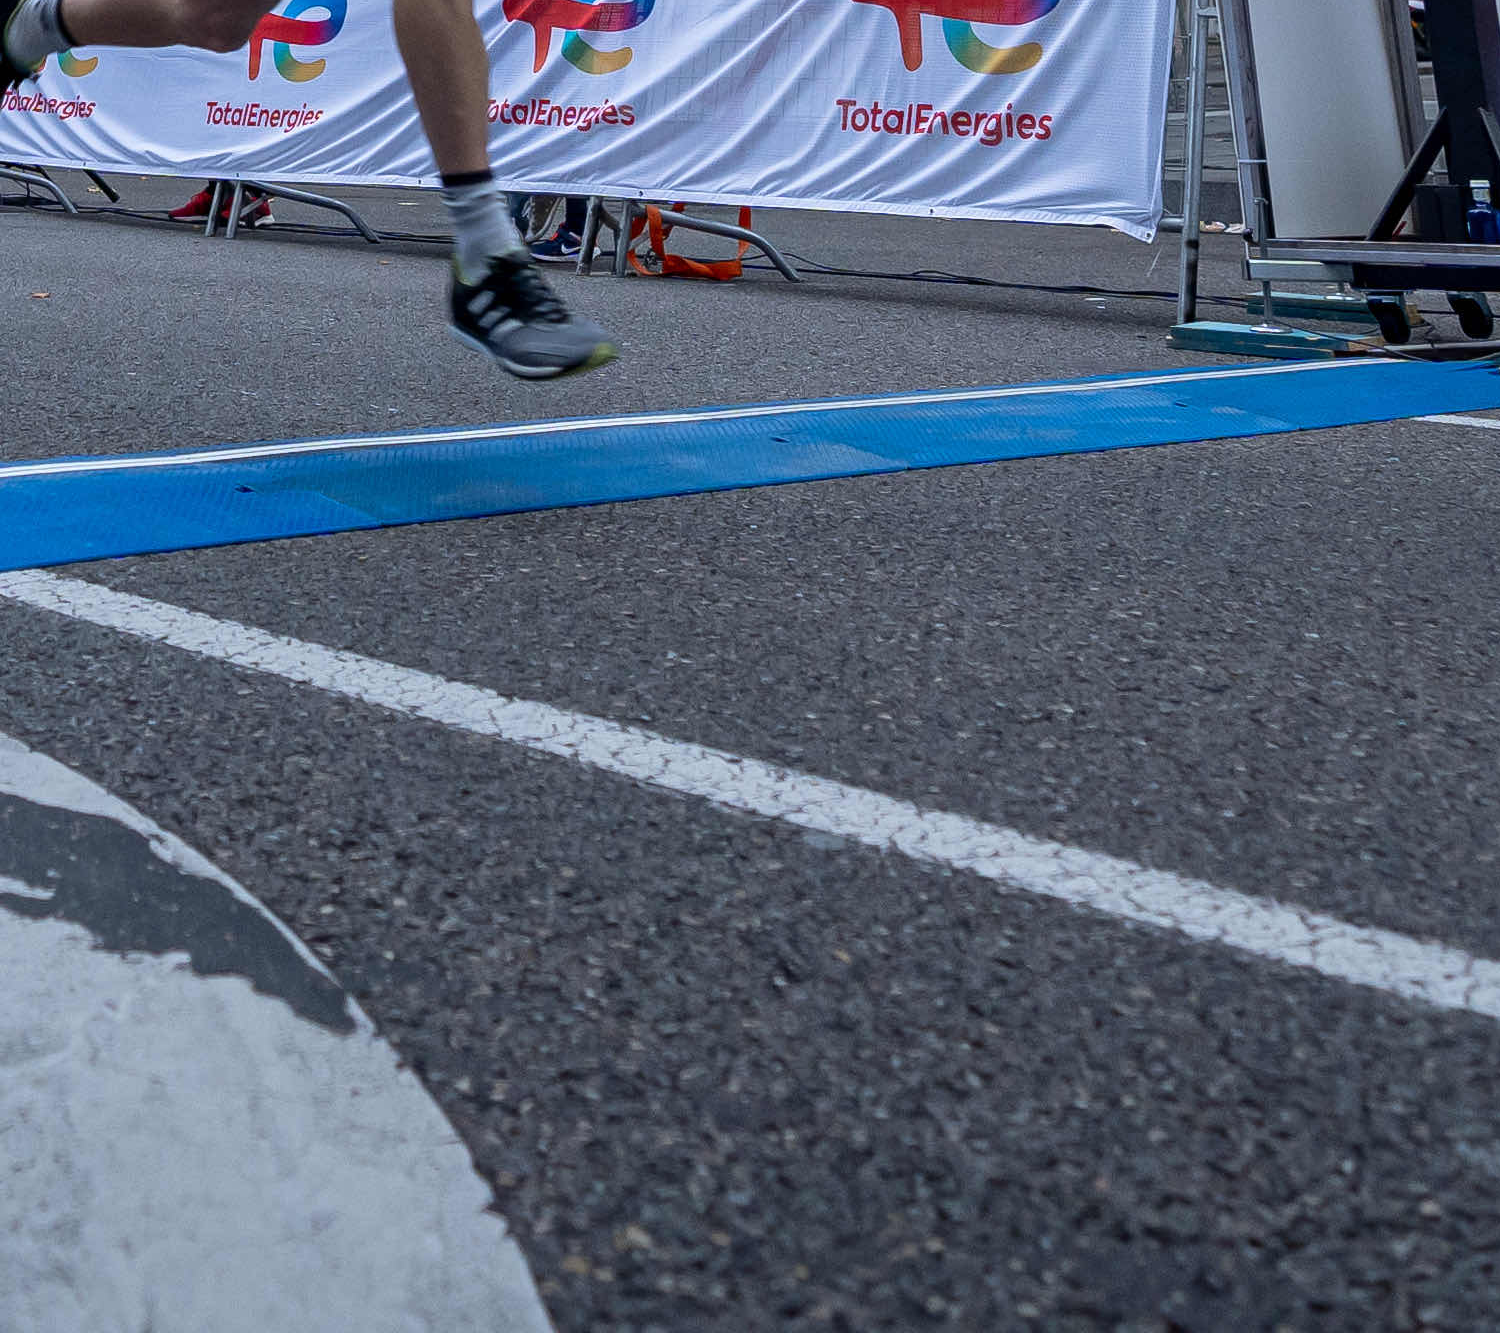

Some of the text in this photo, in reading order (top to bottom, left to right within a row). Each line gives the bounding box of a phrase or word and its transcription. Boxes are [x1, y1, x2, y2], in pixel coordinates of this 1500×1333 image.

[1, 88, 97, 120] TotalEnergies
[206, 100, 325, 133] TotalEnergies
[837, 98, 1053, 148] TotalEnergies
